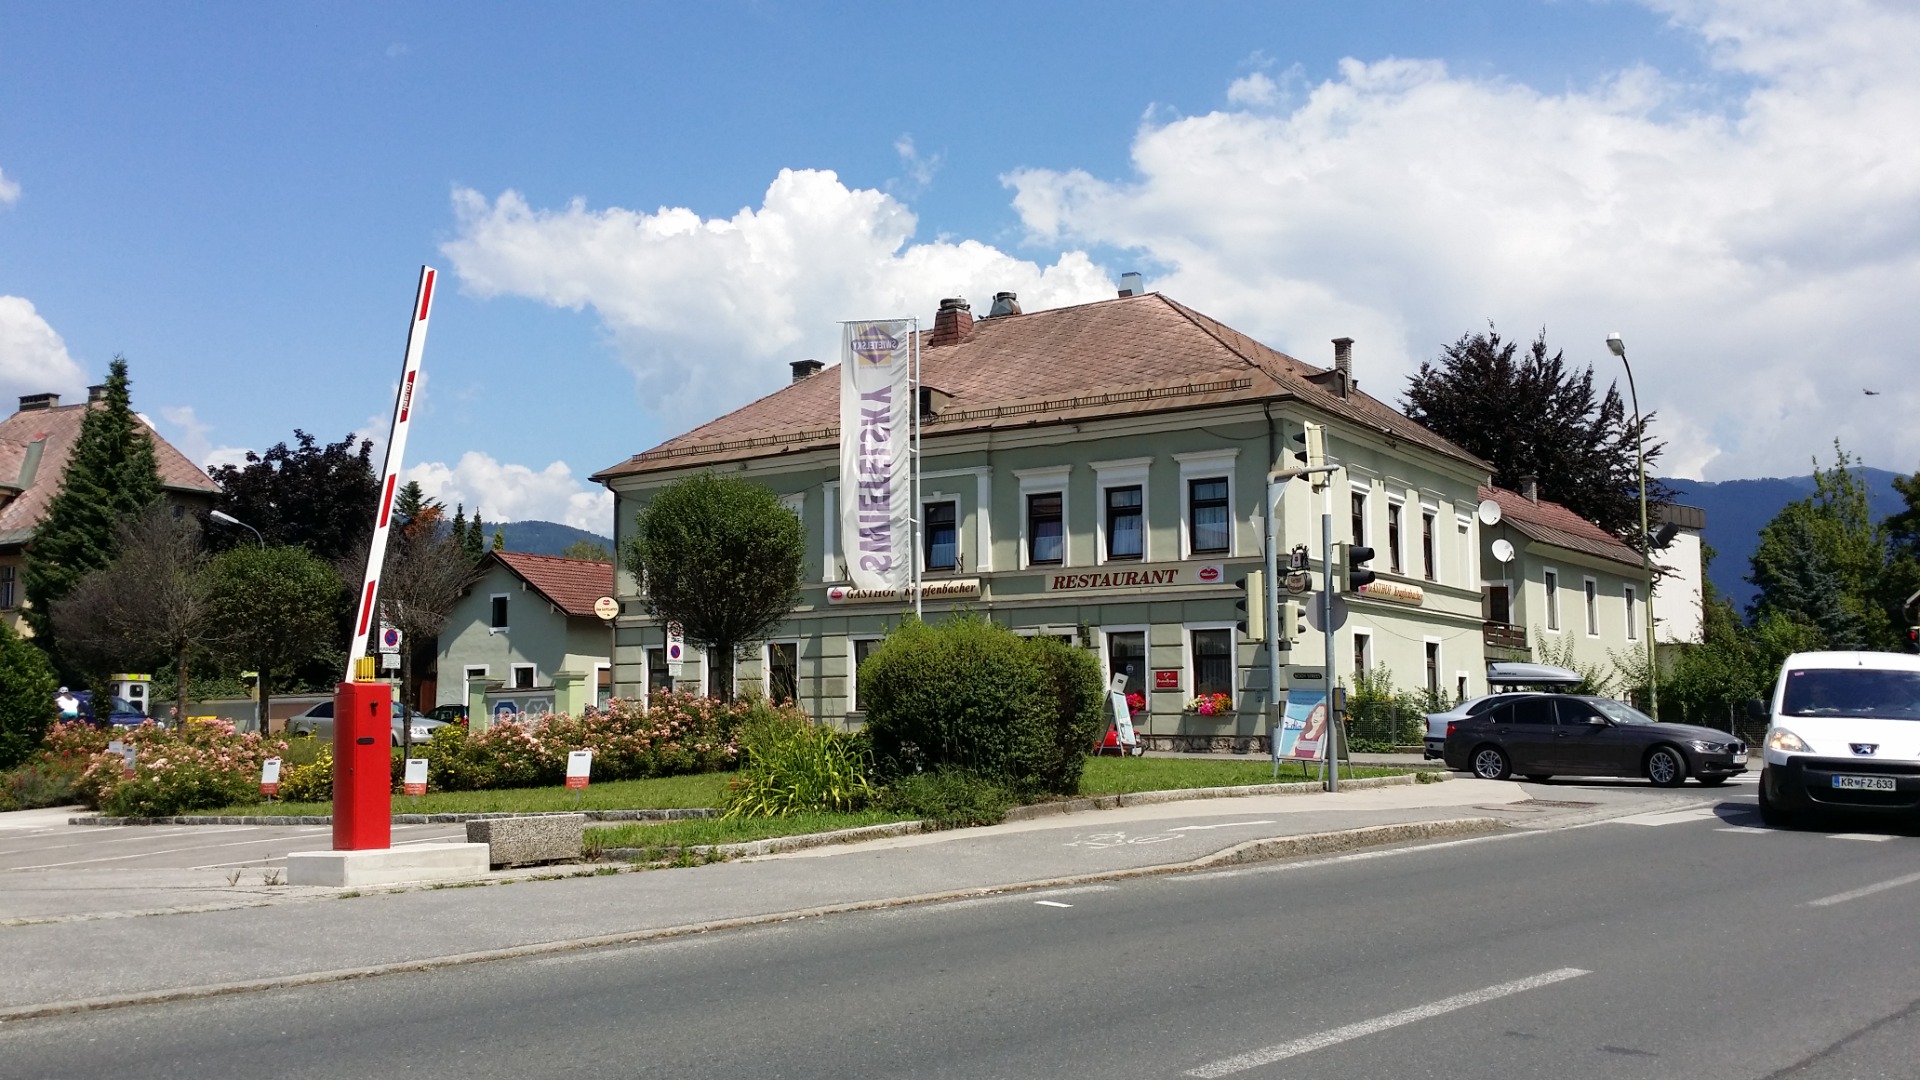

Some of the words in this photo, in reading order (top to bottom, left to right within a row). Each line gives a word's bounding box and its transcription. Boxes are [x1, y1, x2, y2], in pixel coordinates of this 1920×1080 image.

[1052, 569, 1179, 590] RESTAURANT
[904, 582, 976, 598] Krpfenbacher
[1841, 777, 1854, 787] KR
[1860, 779, 1893, 789] FZ-633
